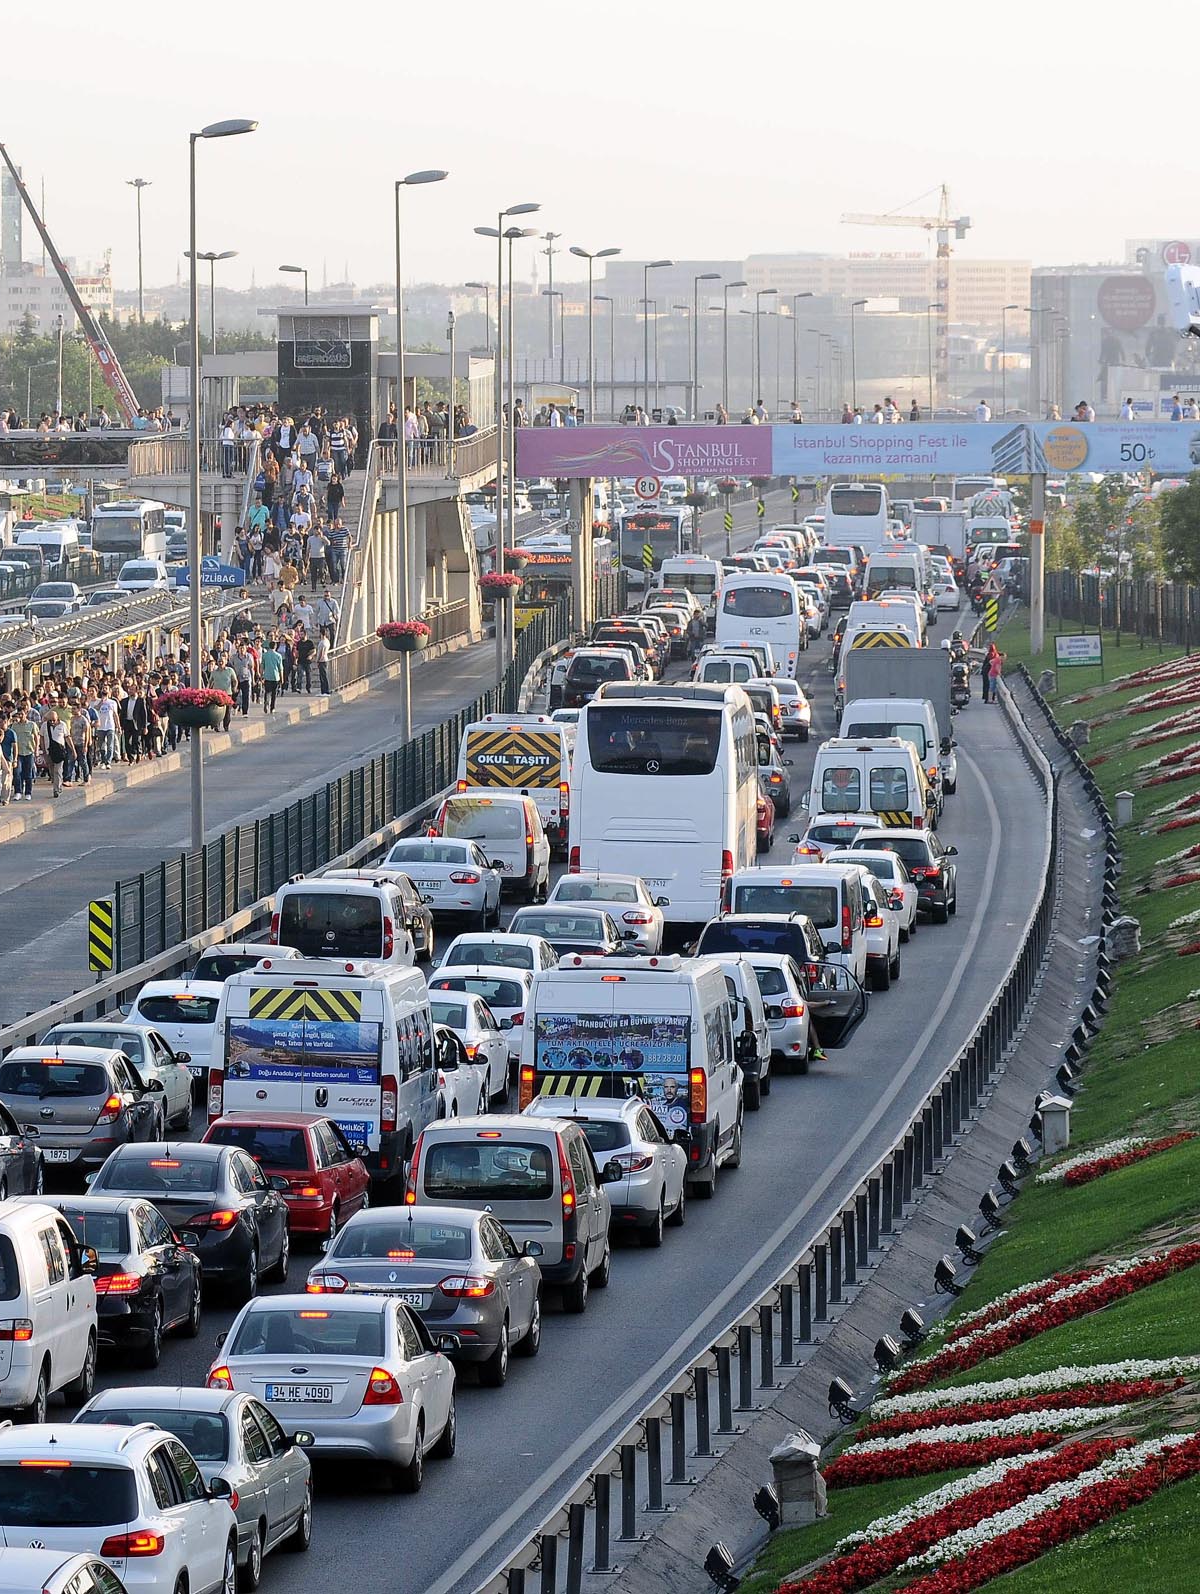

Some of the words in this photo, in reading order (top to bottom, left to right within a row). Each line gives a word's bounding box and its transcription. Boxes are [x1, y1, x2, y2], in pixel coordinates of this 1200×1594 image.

[850, 435, 913, 451] Shopping
[918, 434, 948, 448] Fest
[951, 434, 968, 447] ile
[823, 451, 882, 464] kazanma
[640, 481, 655, 493] 80
[477, 754, 509, 764] OKUL
[513, 755, 550, 766] TAŞITI
[50, 1150, 68, 1159] 1875
[273, 1387, 285, 1397] 34
[288, 1387, 300, 1397] HE
[305, 1387, 330, 1398] 4090
